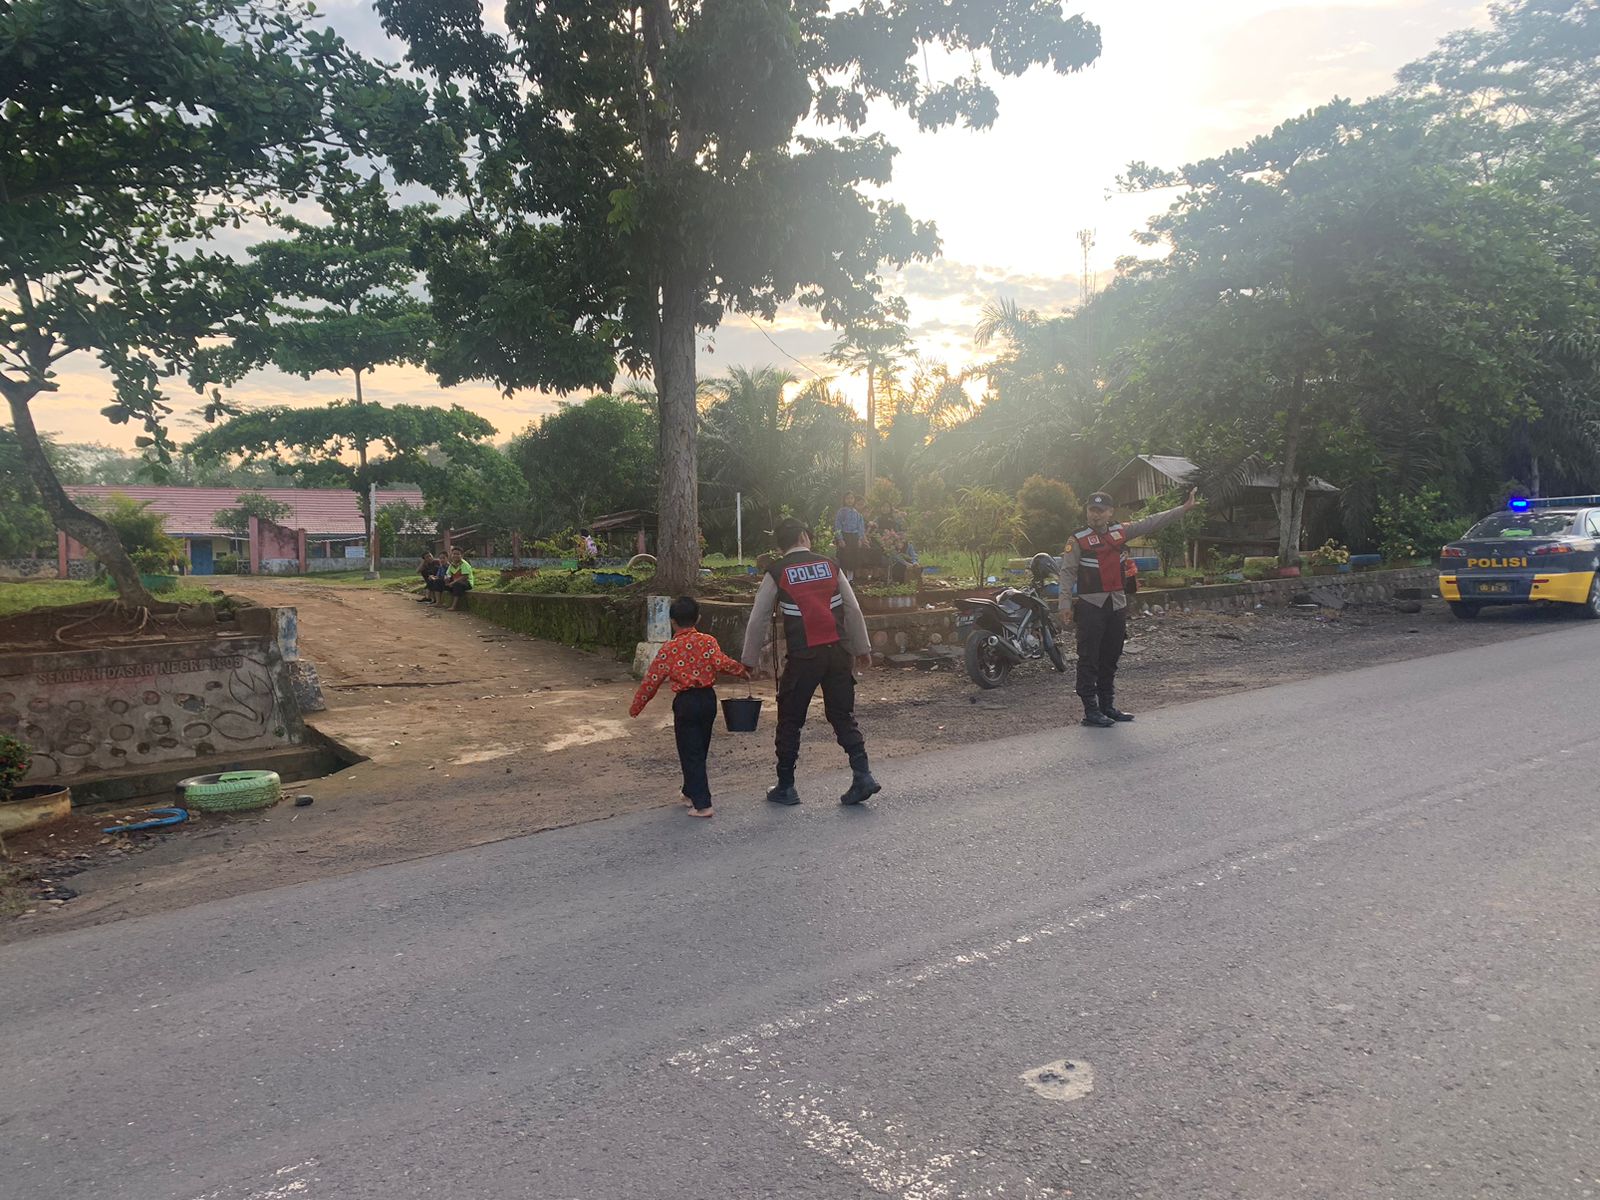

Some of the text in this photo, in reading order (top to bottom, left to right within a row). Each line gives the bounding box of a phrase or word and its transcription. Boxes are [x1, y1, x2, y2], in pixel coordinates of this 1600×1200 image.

[1467, 557, 1527, 568] POLISI
[787, 563, 831, 582] POLISI
[38, 667, 106, 685] SEKOLAH
[107, 663, 153, 679] DASAR
